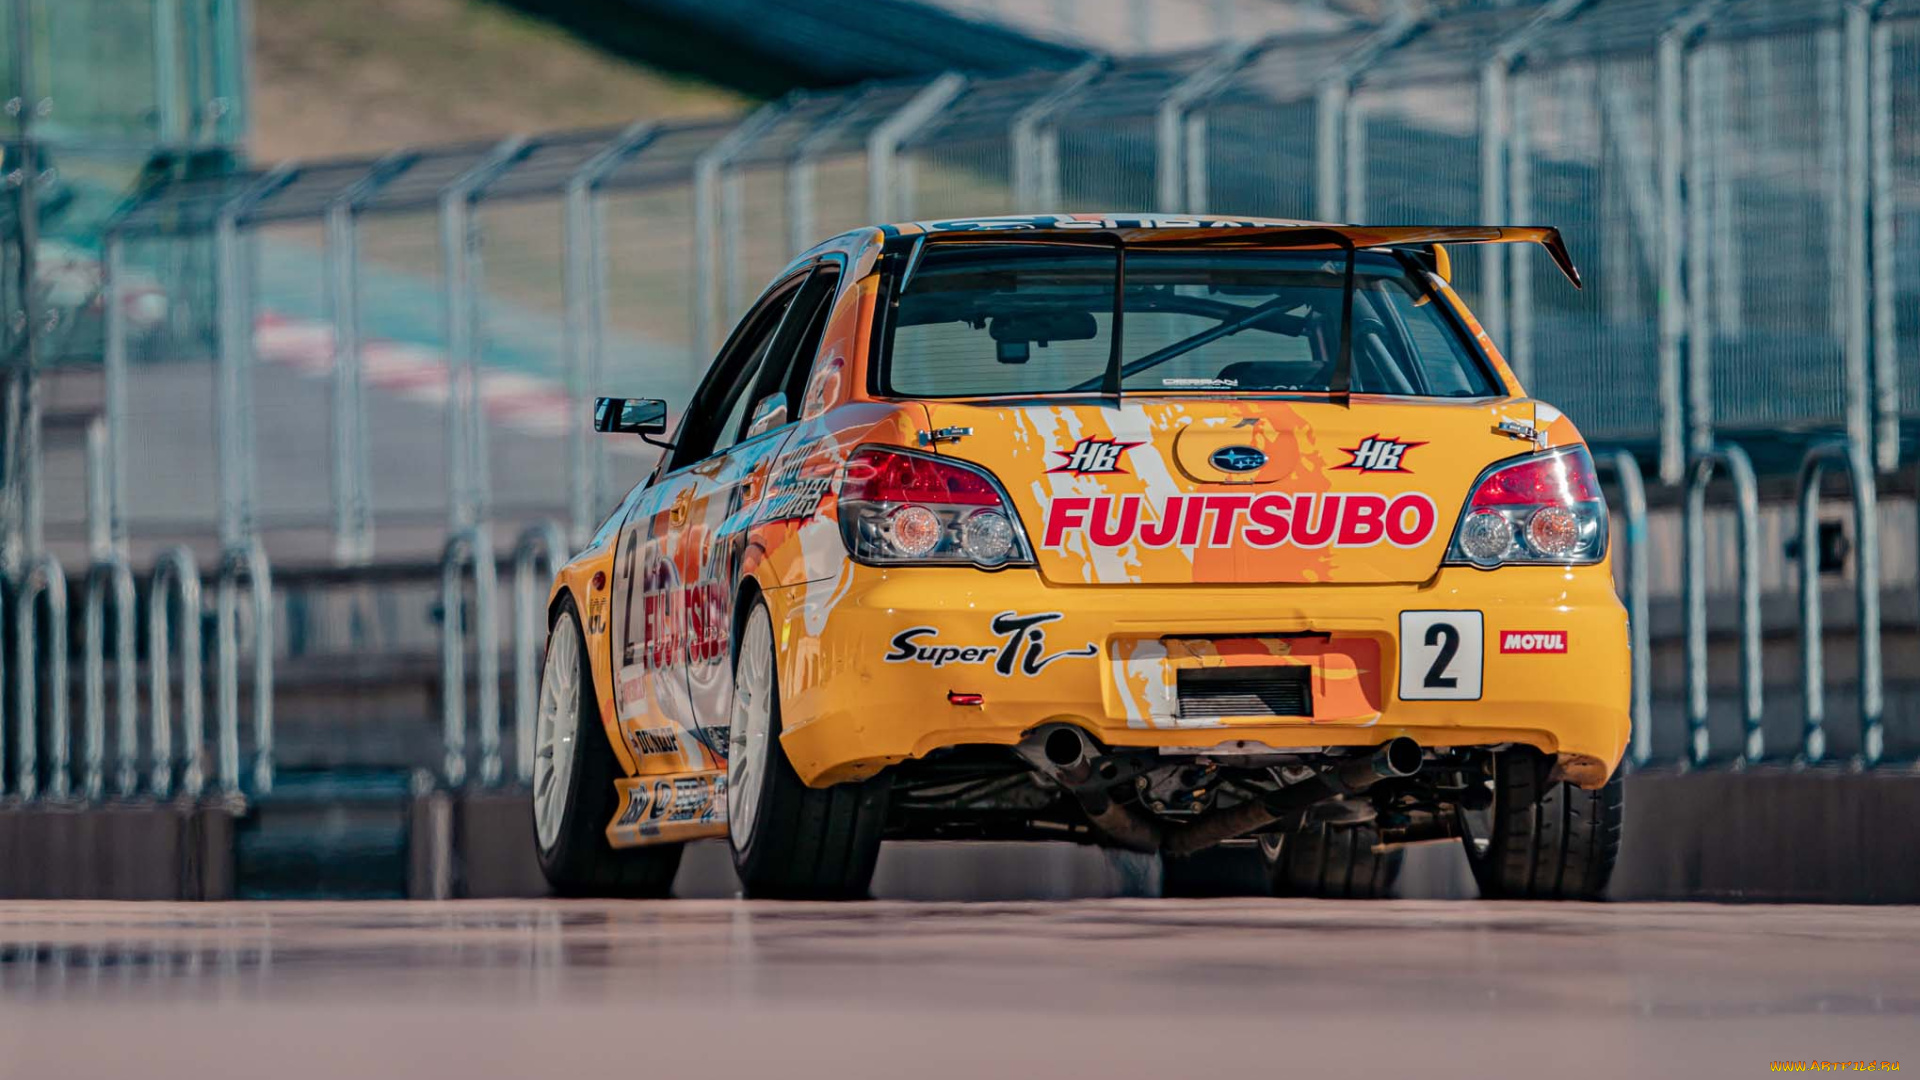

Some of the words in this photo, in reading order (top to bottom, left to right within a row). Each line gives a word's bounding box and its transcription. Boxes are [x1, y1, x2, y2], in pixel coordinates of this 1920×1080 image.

[1043, 493, 1436, 548] FUJITSUBO
[623, 529, 637, 667] 2
[885, 628, 997, 667] Super
[991, 611, 1098, 676] Ti
[1423, 622, 1460, 688] 2
[1503, 633, 1565, 651] MOTUL
